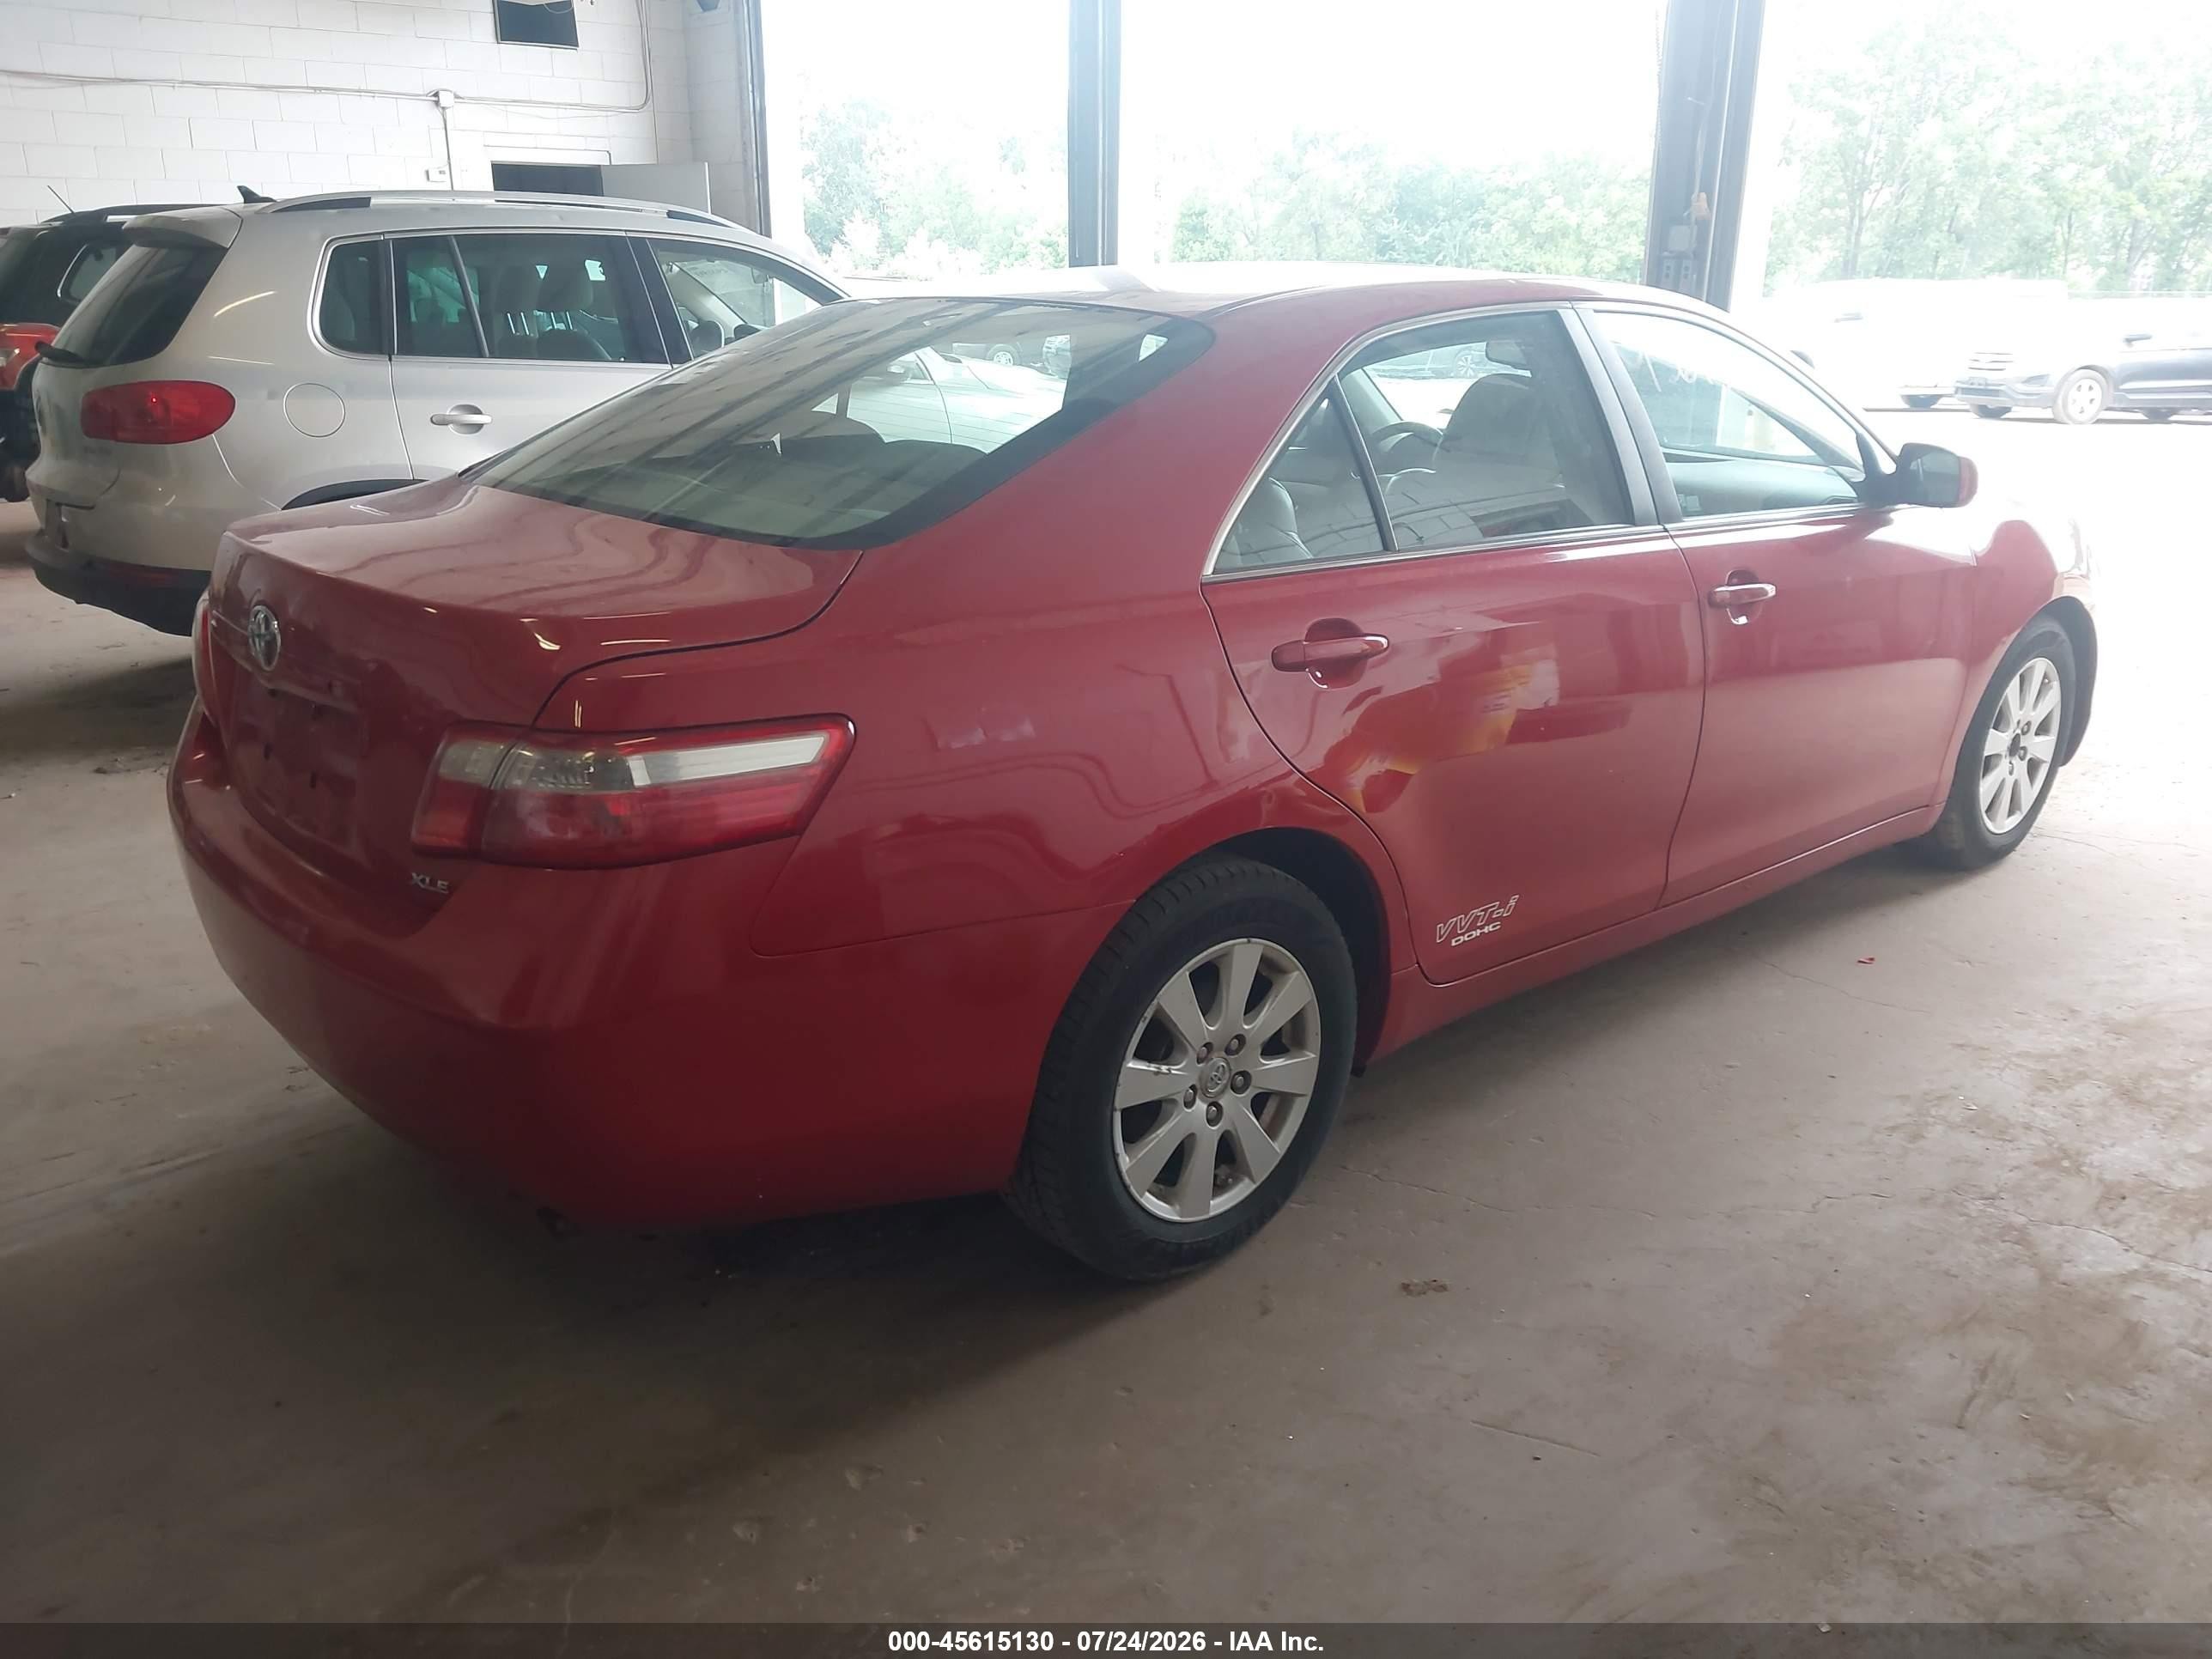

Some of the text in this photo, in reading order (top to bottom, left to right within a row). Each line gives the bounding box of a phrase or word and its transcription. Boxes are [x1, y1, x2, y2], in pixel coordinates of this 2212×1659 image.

[411, 872, 449, 894] XLE
[1436, 894, 1520, 944] VVT-i
[1450, 921, 1502, 947] DOHC
